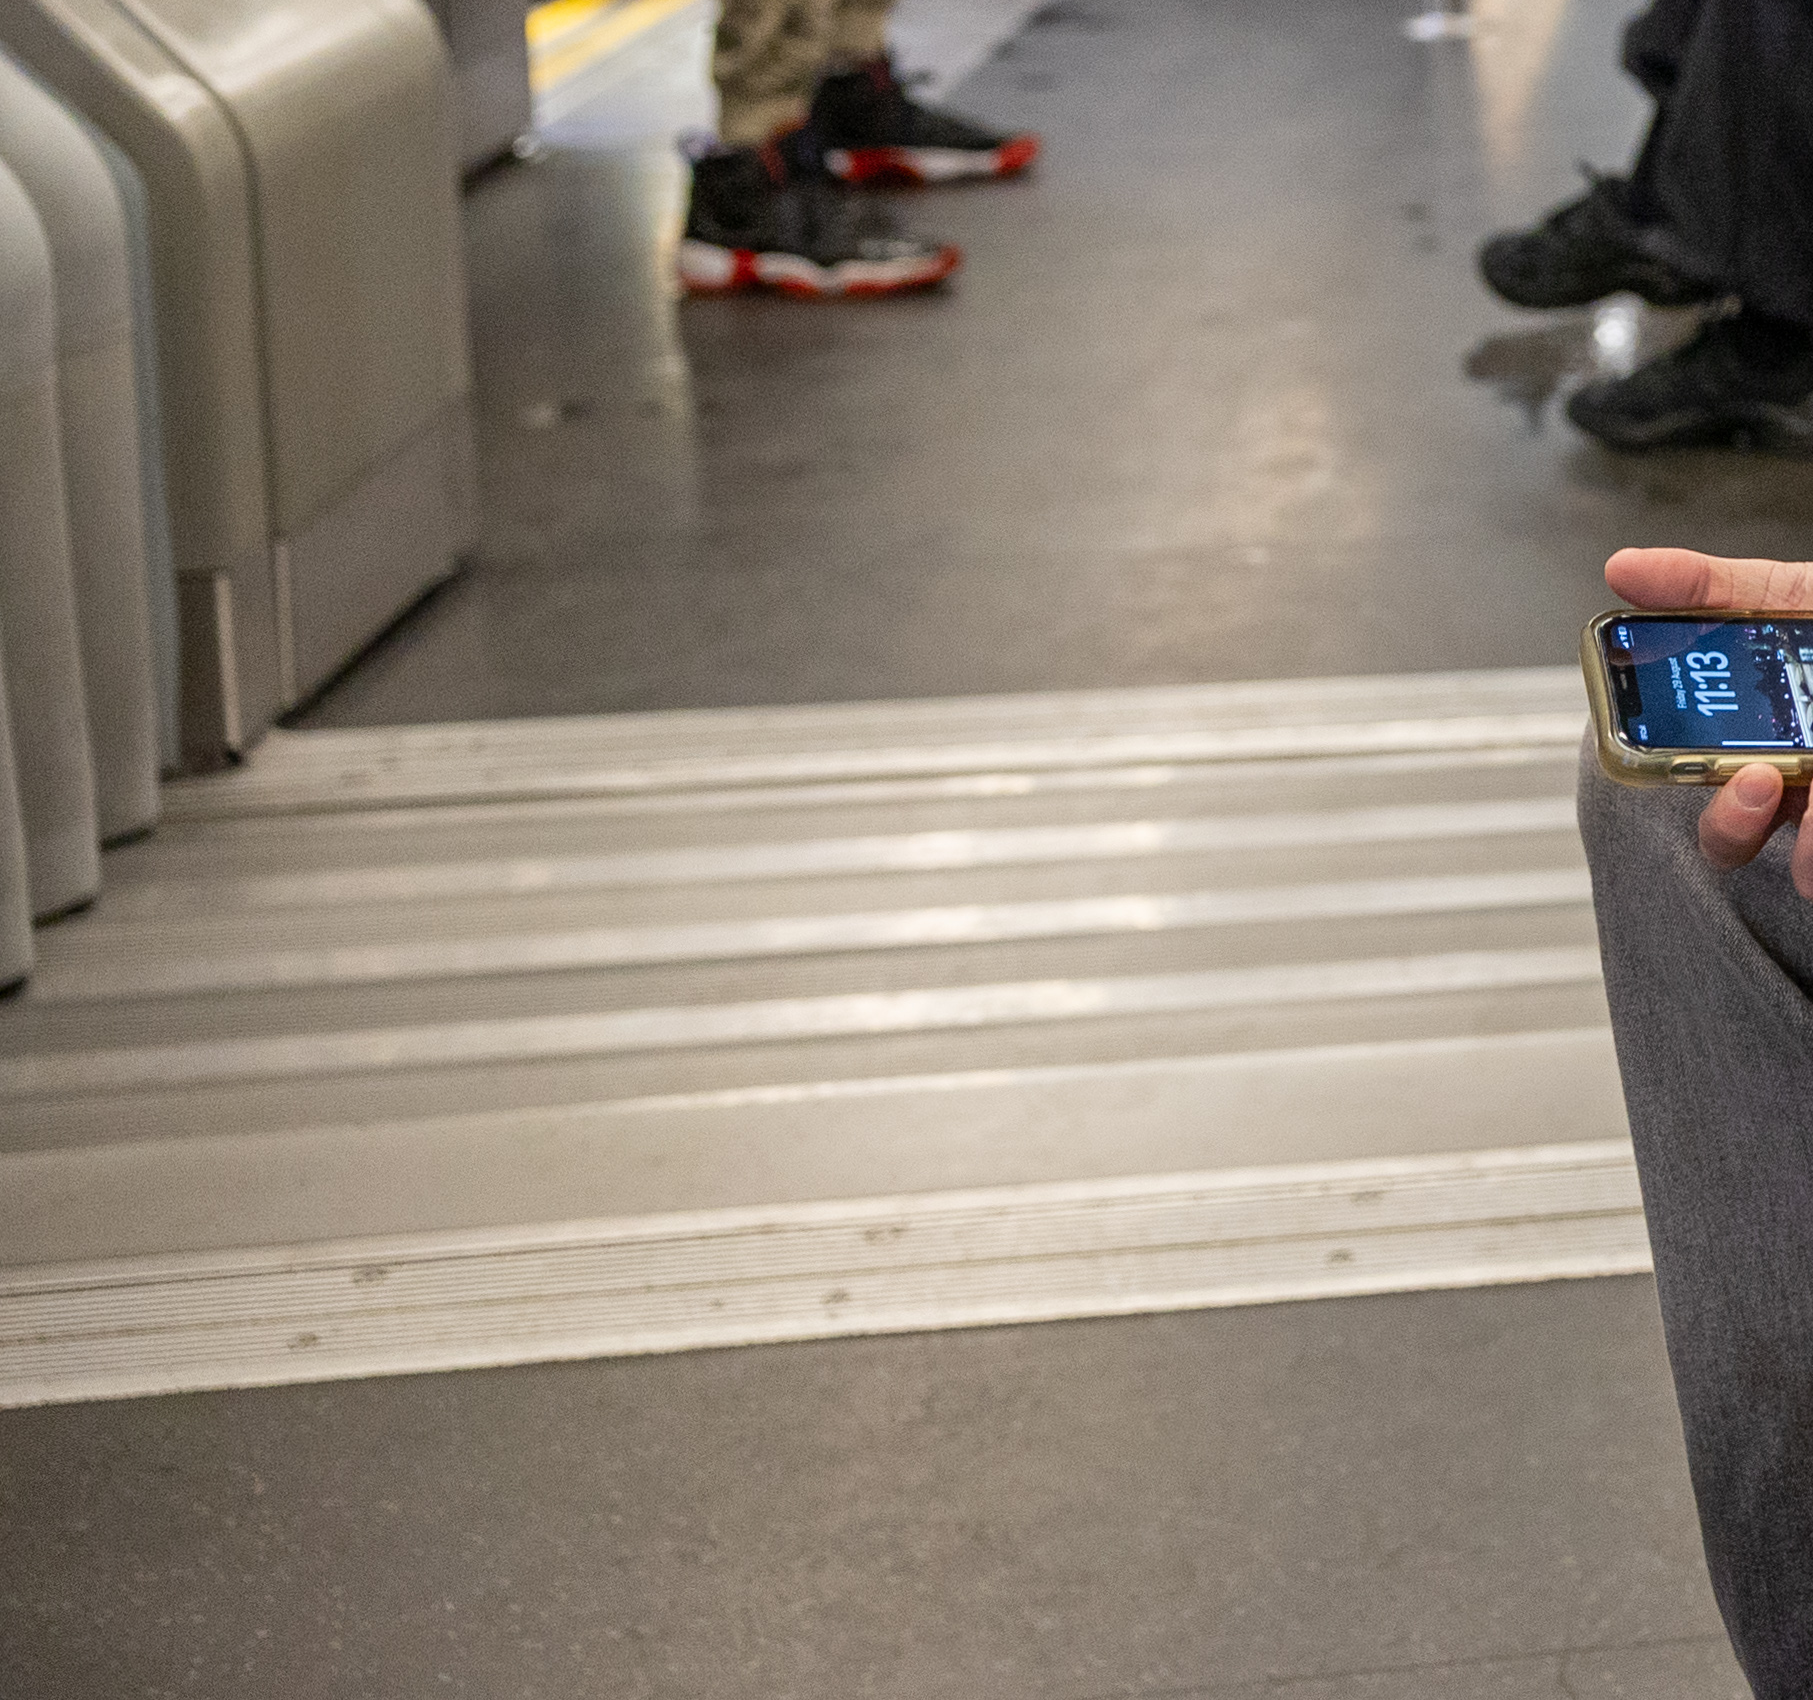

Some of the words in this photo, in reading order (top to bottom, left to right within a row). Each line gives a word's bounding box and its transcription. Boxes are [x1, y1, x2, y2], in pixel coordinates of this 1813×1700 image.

[1668, 658, 1681, 679] August
[1672, 680, 1683, 689] 29
[1686, 651, 1739, 716] 11:13
[1677, 690, 1687, 708] Friday
